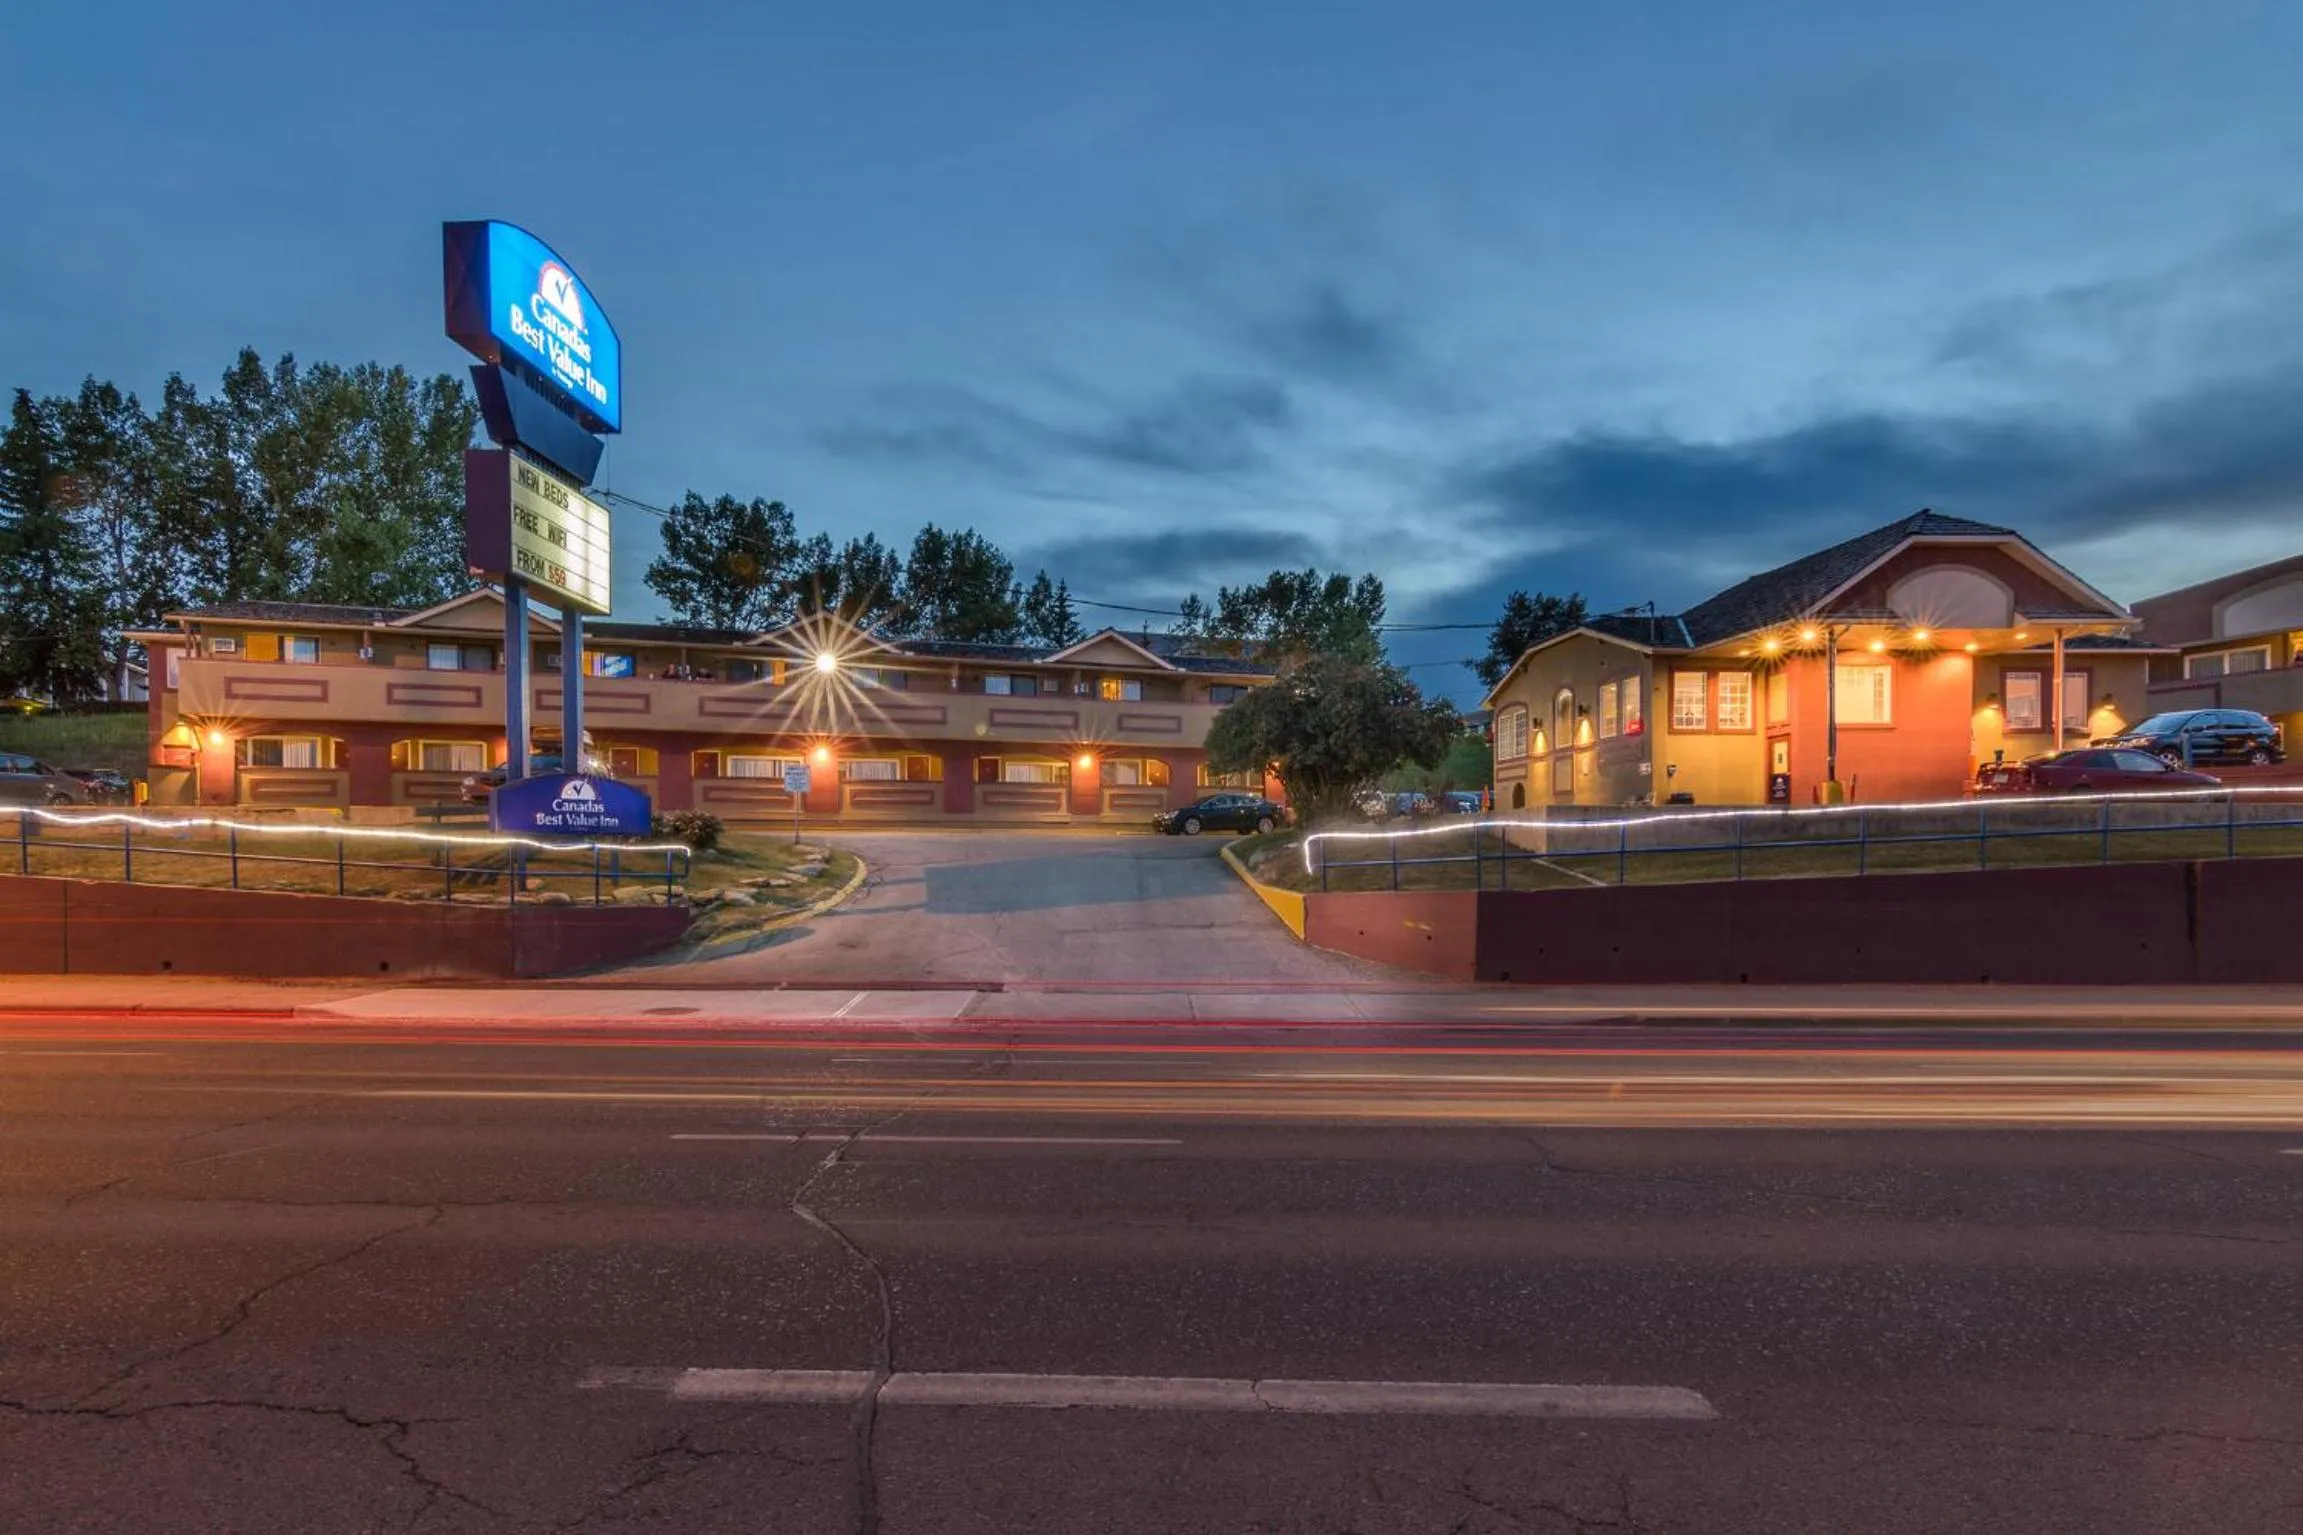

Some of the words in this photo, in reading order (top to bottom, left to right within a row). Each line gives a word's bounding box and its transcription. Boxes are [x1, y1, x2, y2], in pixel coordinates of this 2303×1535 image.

[510, 303, 545, 354] Best
[548, 335, 586, 386] Value
[586, 367, 607, 404] Inn
[518, 464, 540, 494] NEW
[545, 480, 569, 509] BEDS
[514, 506, 538, 535] FREE
[517, 549, 545, 579] FROM
[535, 812, 563, 826] Best
[566, 813, 598, 827] Value
[601, 814, 619, 827] Inn
